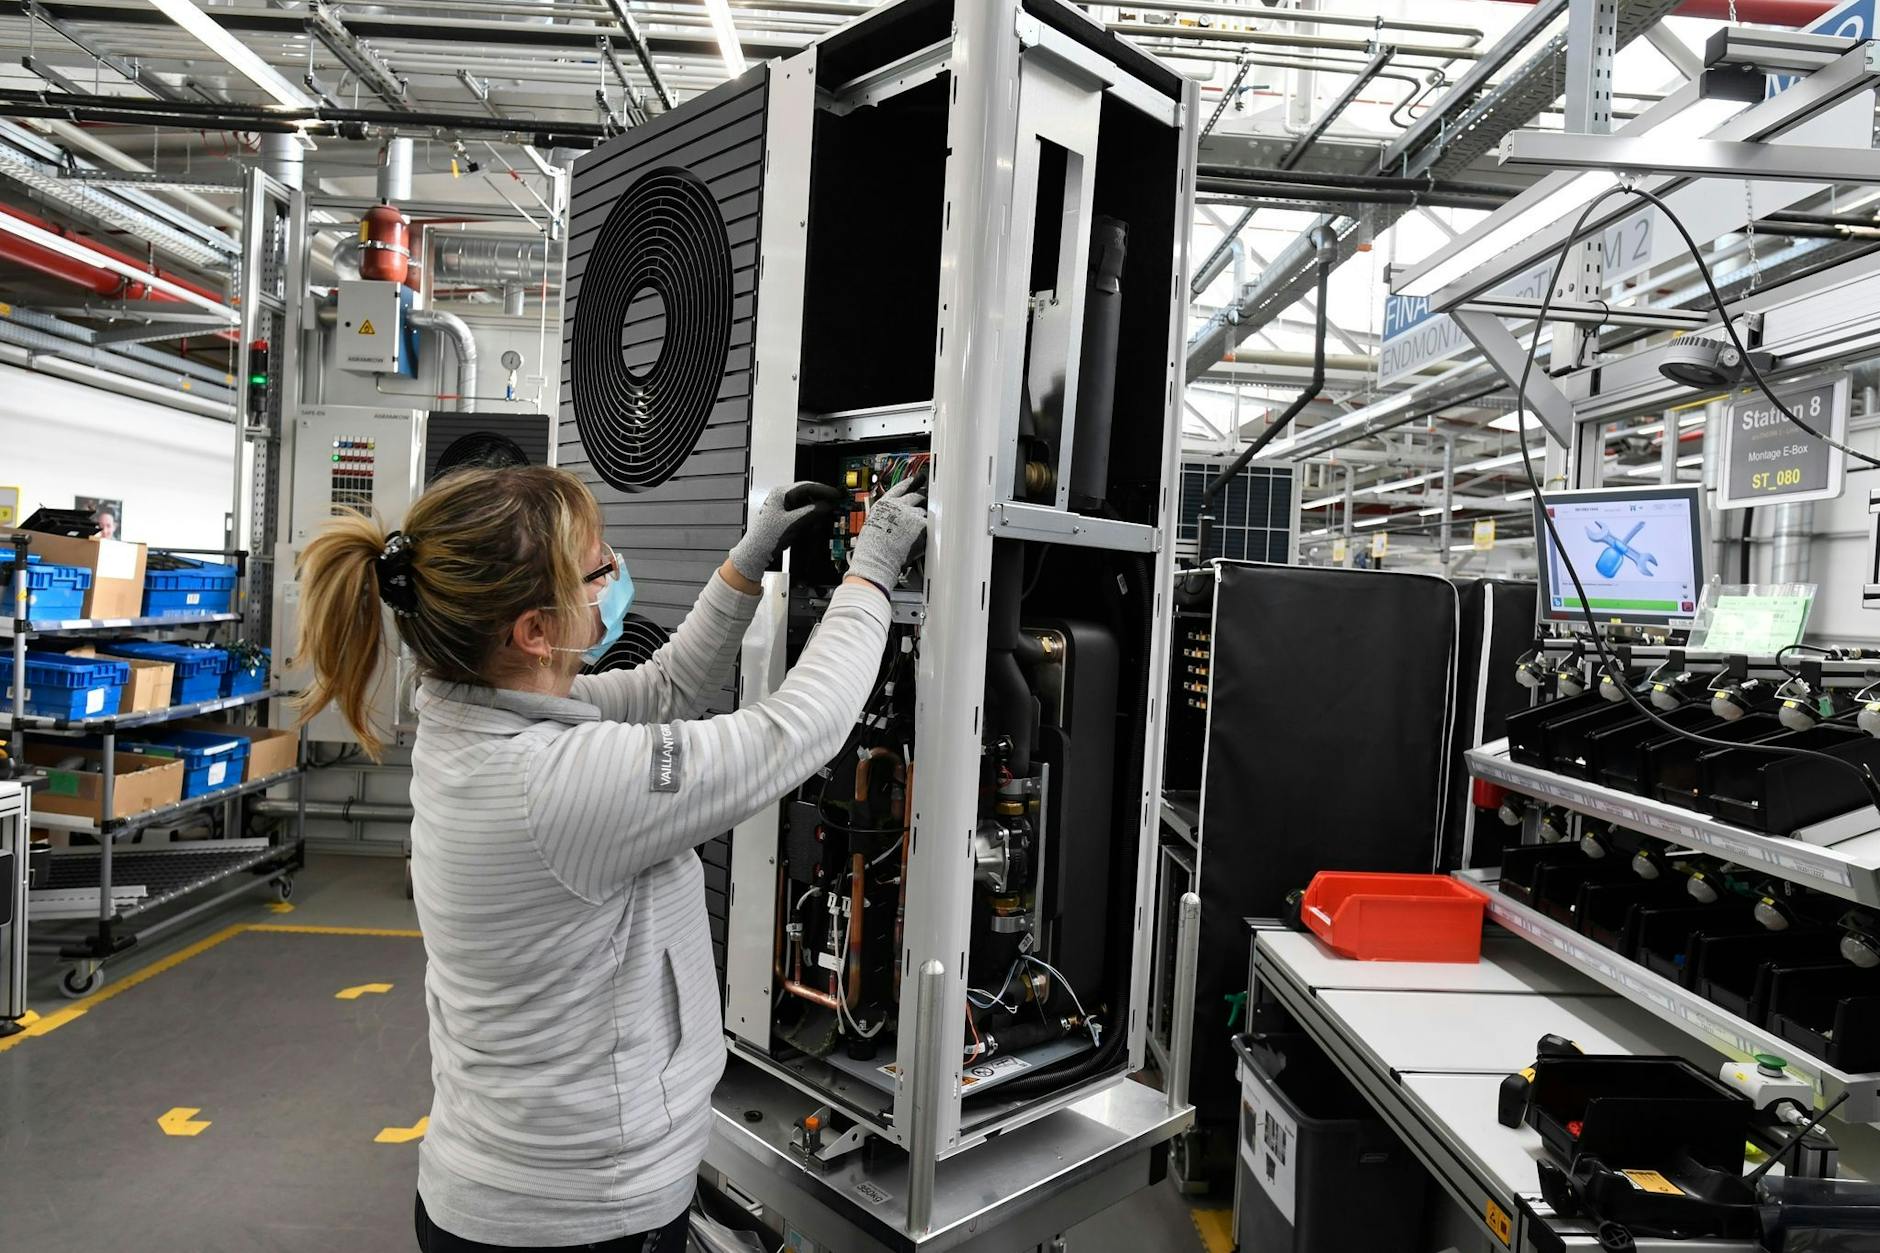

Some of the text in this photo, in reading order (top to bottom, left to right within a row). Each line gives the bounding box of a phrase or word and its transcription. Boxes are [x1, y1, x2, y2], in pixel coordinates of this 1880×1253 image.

[1632, 218, 1649, 261] 2
[1809, 395, 1821, 417] 8
[1748, 444, 1808, 462] Montage E-Box
[1752, 468, 1801, 491] ST_080
[660, 736, 674, 786] VAILLANT
